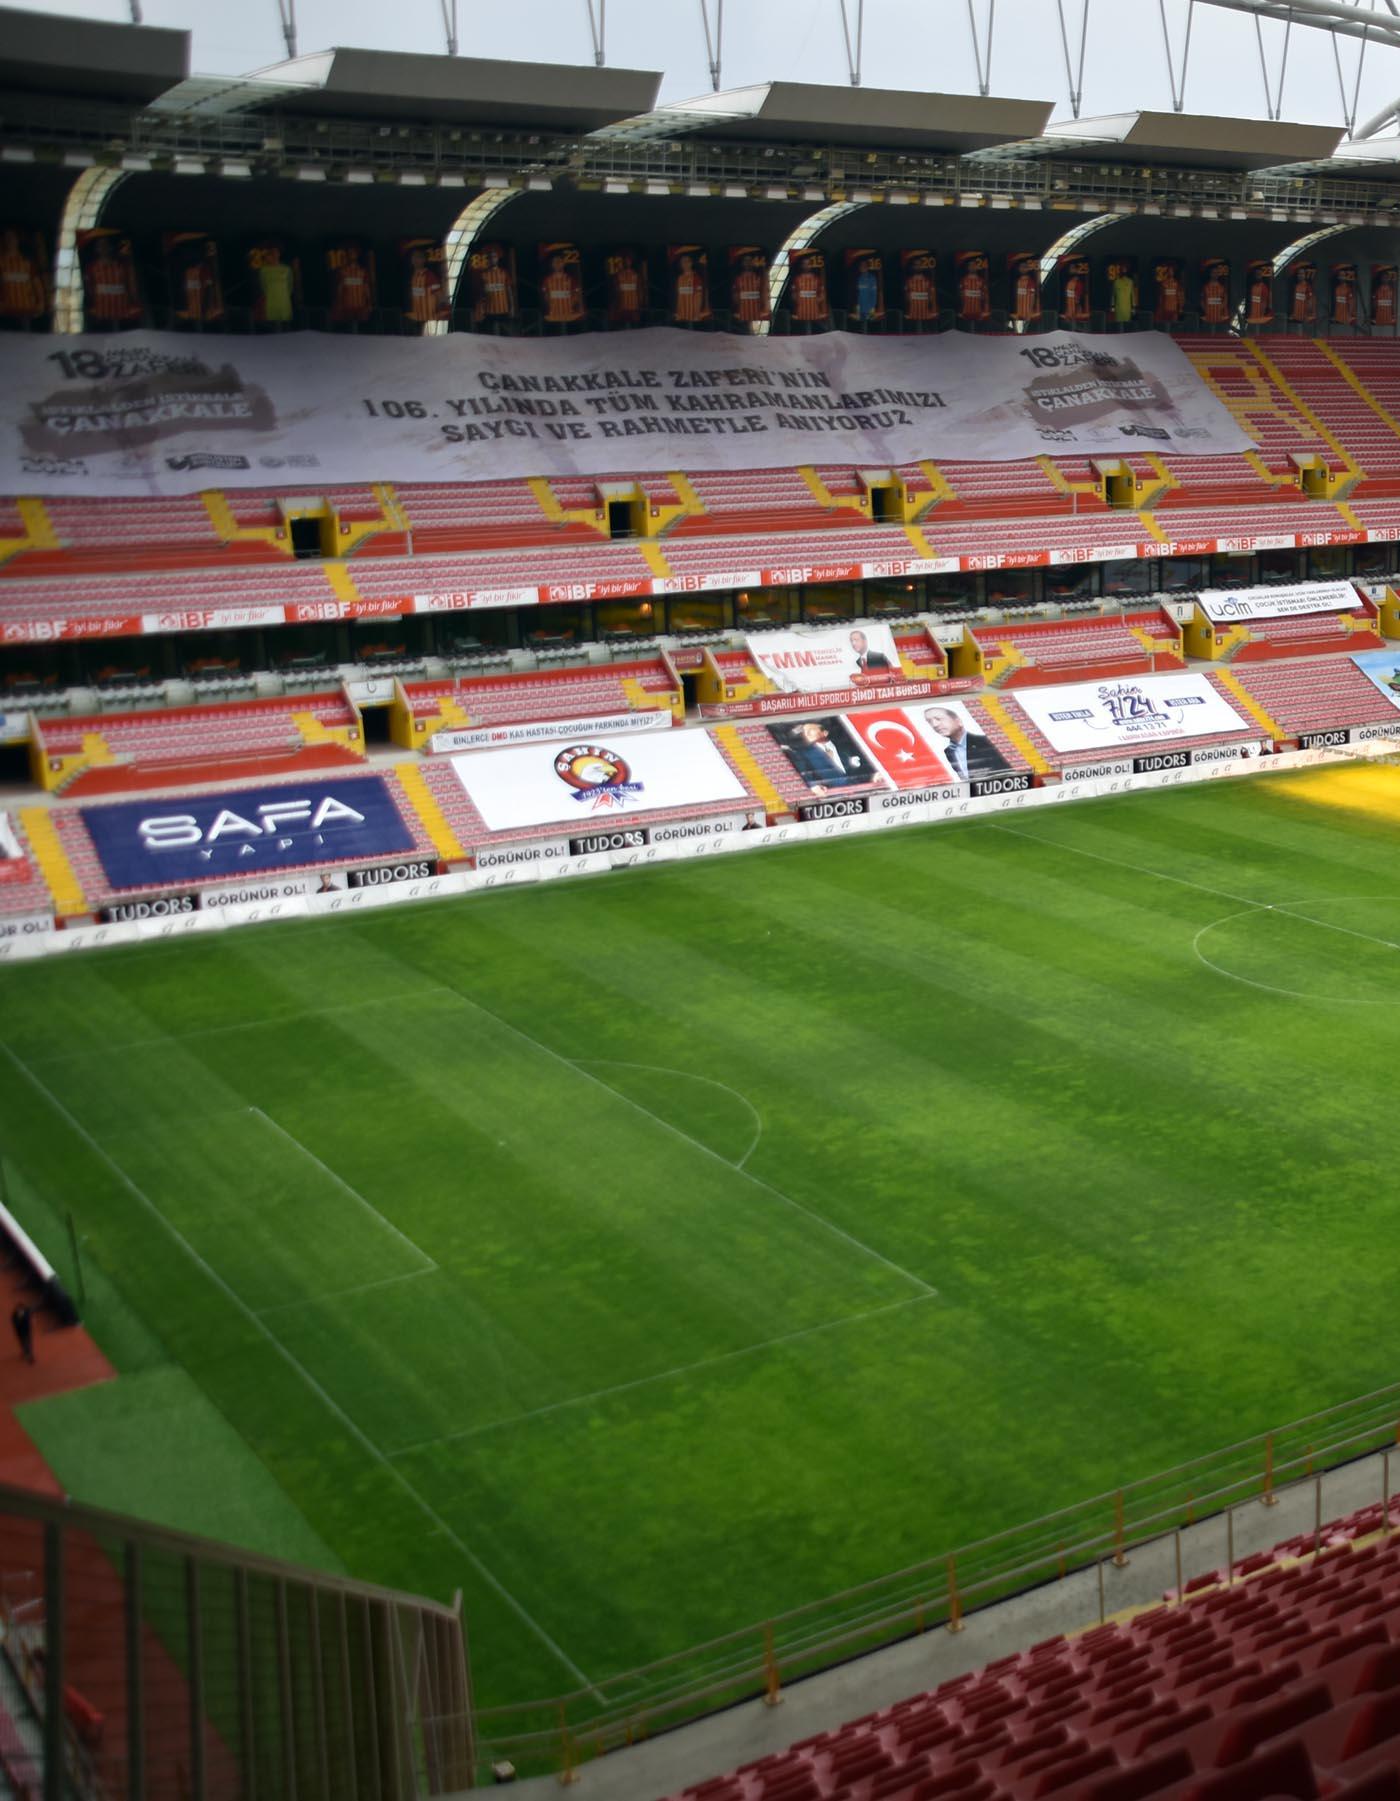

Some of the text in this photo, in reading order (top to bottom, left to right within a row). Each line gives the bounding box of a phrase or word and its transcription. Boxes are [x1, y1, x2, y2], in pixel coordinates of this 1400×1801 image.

[478, 370, 663, 394] ÇANAKKALE
[446, 396, 581, 417] YILINDA
[585, 390, 661, 415] TÜM
[664, 388, 947, 411] KAHRAMANLARIMIZI
[441, 410, 913, 442] SAYGI VE RAHMETLE ANIYORUZ
[760, 697, 797, 713] BAŞARILI
[797, 695, 818, 708] MİLLİ
[819, 693, 850, 706] SPORCU
[851, 688, 876, 704] ŞİMDİ
[877, 687, 896, 700] TAM
[895, 685, 932, 698] BURSLU!
[509, 729, 525, 740] KAS
[595, 719, 630, 731] FARKINDA
[1303, 732, 1346, 748] TUDORS
[1359, 725, 1400, 739] GÖRÜNÜR
[1138, 752, 1187, 771] TUDORS
[1194, 747, 1238, 763] GÖRÜNÜR
[1064, 763, 1131, 781] GÖRÜNÜR OL!
[976, 776, 1029, 796] TUDORS
[882, 787, 961, 808] GÖRÜNÜR OL!
[805, 800, 863, 820] TUDORS
[138, 796, 365, 849] SAFA
[654, 820, 733, 842] GÖRÜNÜR OL!
[201, 834, 326, 862] YAPI
[577, 831, 644, 854] TUDORS
[479, 845, 565, 868] GÖRÜNÜR OL!
[356, 862, 430, 887] TUDORS
[207, 883, 306, 908] GÖRÜNÜR OL!
[109, 896, 193, 922] TUDORS
[24, 920, 50, 935] OL!
